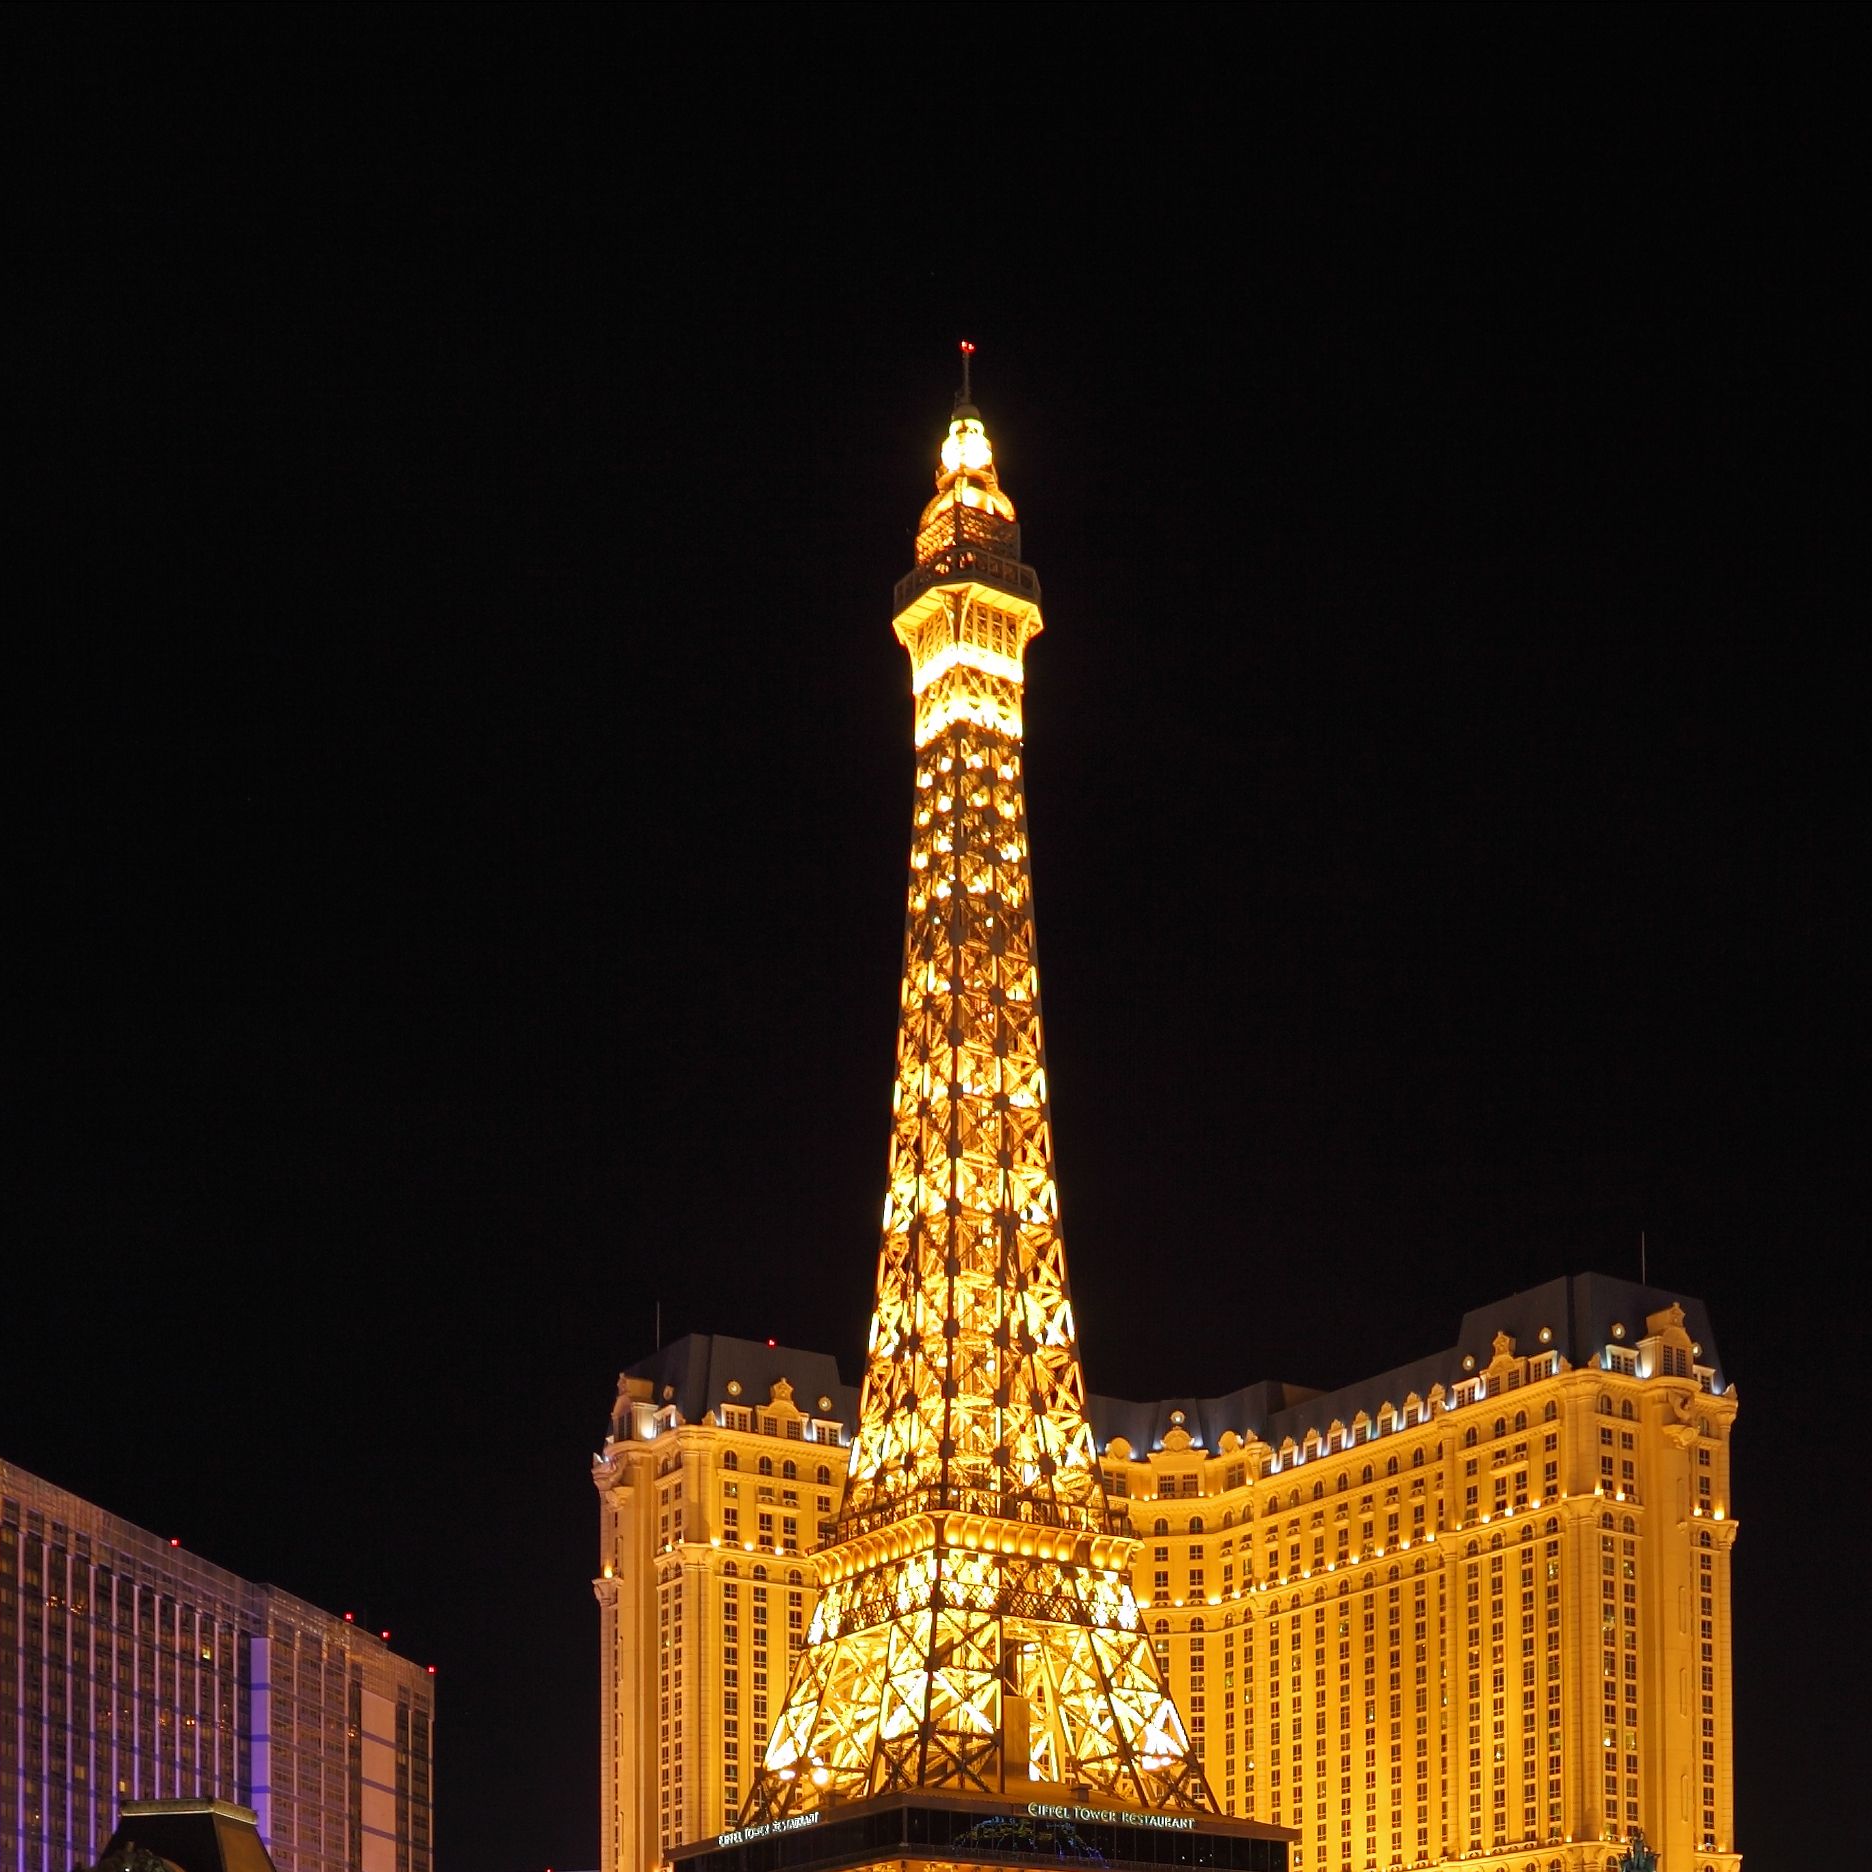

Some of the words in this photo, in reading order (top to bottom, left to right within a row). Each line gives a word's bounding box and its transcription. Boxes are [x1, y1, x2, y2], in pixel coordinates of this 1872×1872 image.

[1028, 1802, 1070, 1819] EIFFEL
[1073, 1805, 1116, 1822] TOWER
[1121, 1811, 1195, 1830] RESTAURANT
